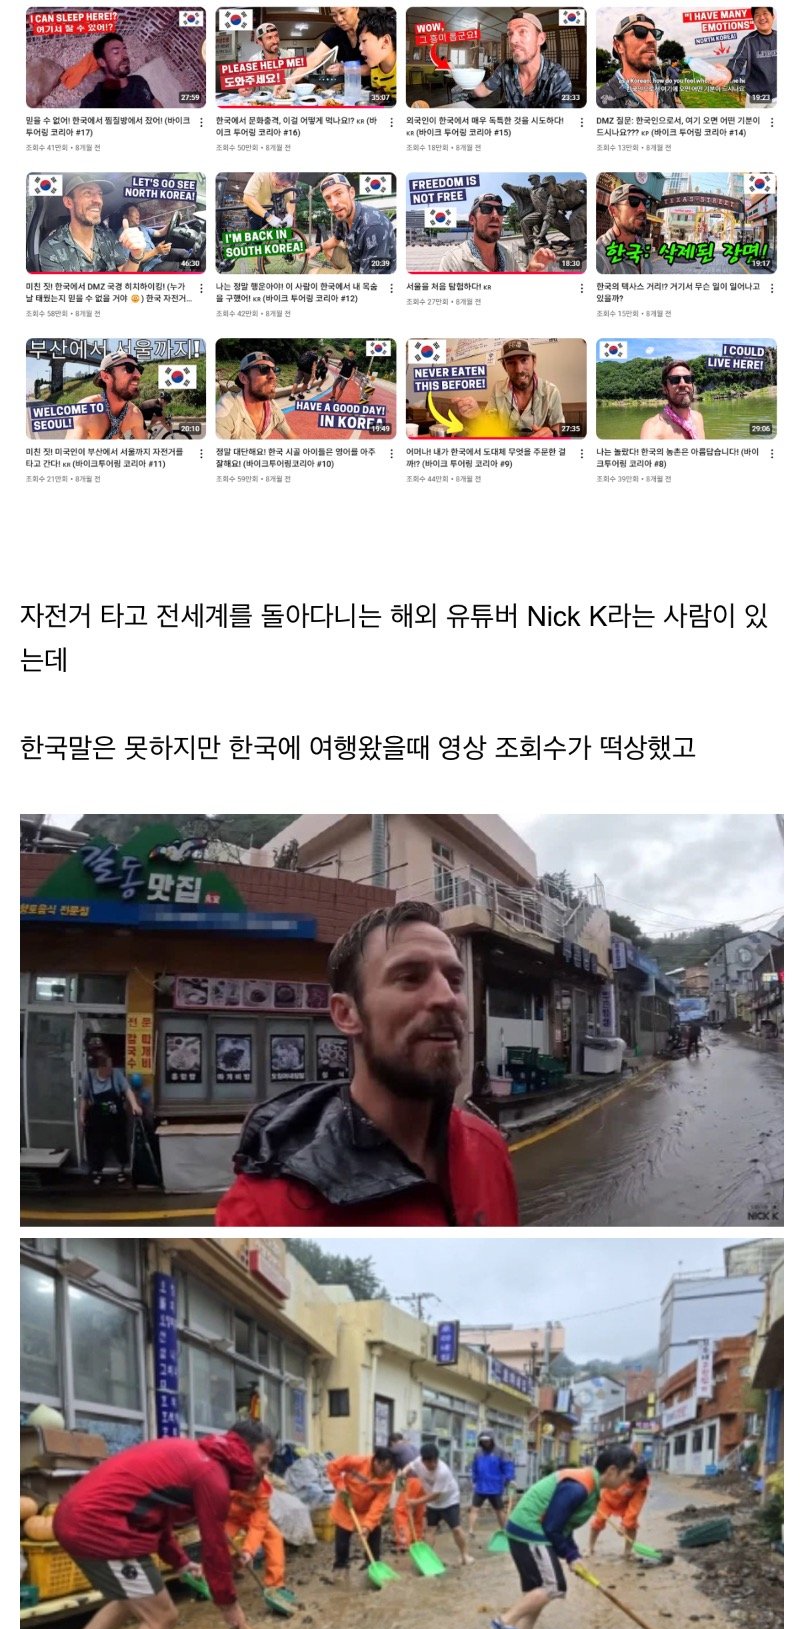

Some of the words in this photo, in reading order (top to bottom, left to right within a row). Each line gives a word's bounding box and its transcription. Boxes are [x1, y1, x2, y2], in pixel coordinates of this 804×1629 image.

[26, 448, 41, 456] 미친
[43, 448, 53, 456] 짓!
[55, 448, 85, 456] 미국인이
[88, 448, 118, 456] 부산에서
[120, 448, 150, 456] 서울까지
[152, 448, 183, 456] 자전거를
[147, 872, 202, 904] 맛집
